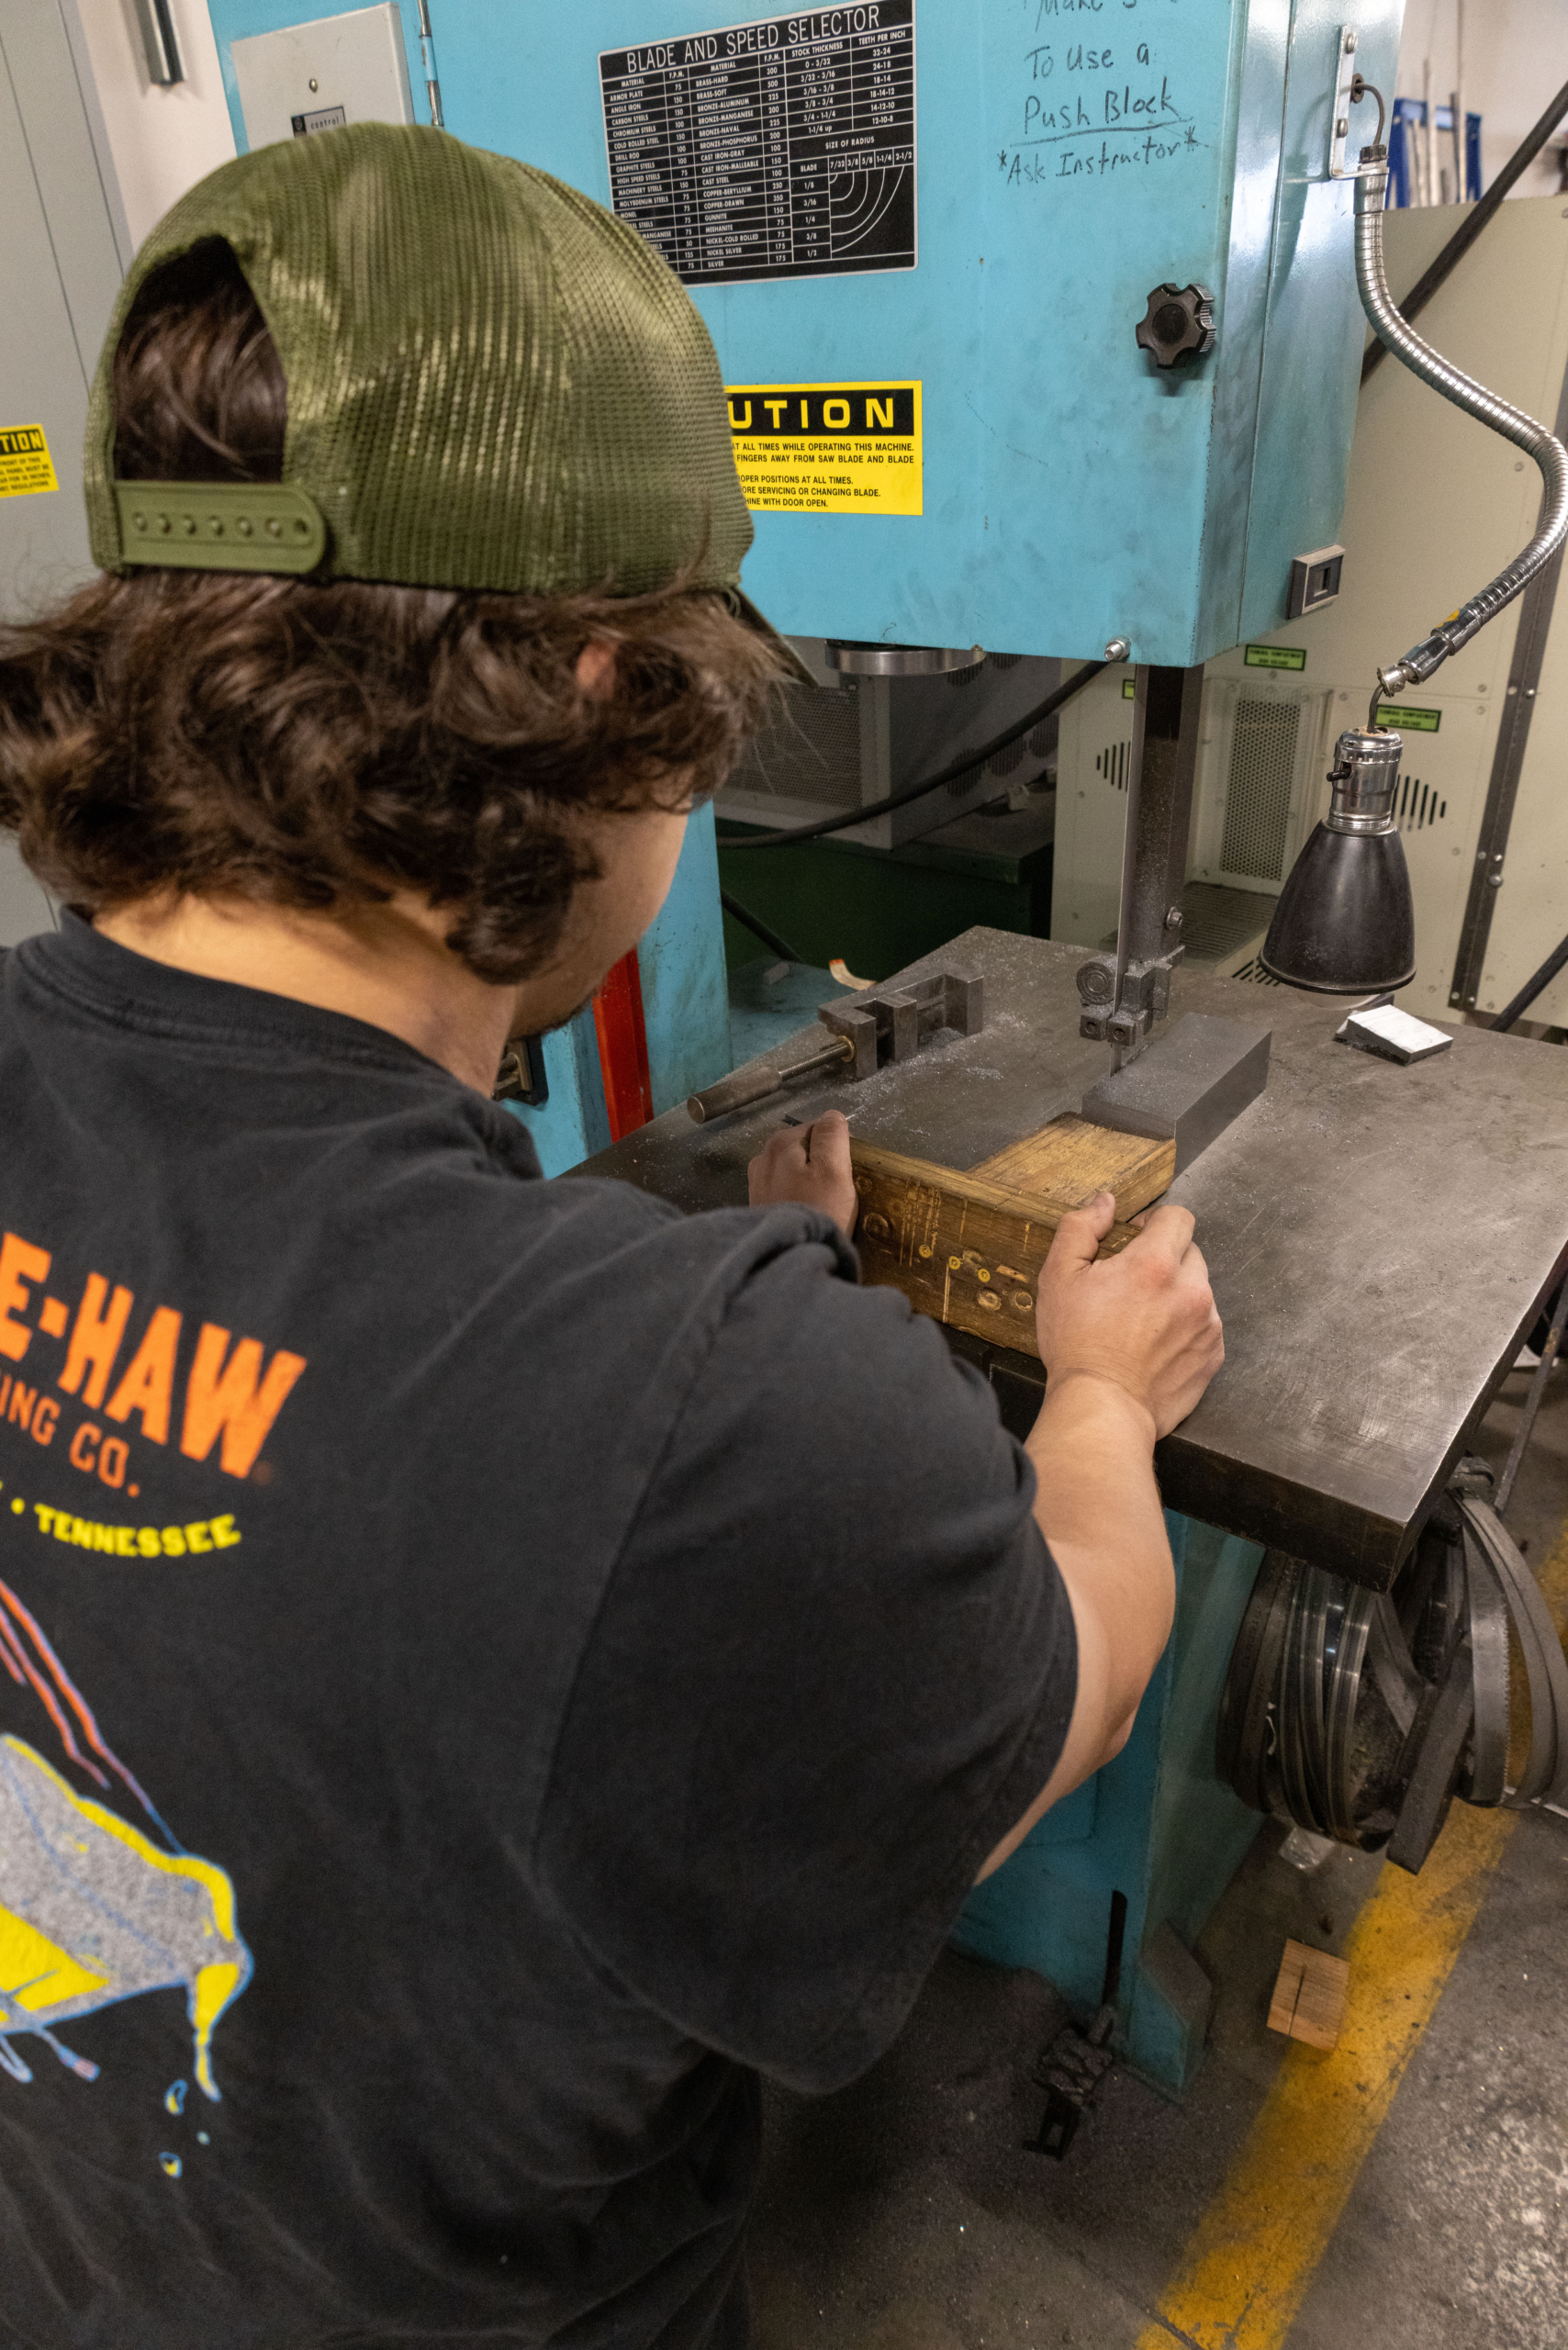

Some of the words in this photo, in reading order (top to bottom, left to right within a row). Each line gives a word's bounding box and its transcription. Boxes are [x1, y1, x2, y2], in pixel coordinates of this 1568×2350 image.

[628, 45, 677, 74] BLADE
[685, 37, 718, 63] AND
[726, 25, 778, 54] SPEED
[789, 6, 879, 44] SELECTOR
[858, 36, 875, 46] TEETH
[878, 33, 889, 42] PER
[890, 30, 905, 39] INCH
[792, 48, 810, 58] STOCK
[812, 42, 843, 55] THICKNESS
[873, 47, 890, 57] 32-24
[765, 53, 780, 62] F.P.M.
[816, 57, 830, 68] 3/32
[1025, 45, 1054, 80] To
[1067, 44, 1114, 71] Use
[711, 62, 735, 72] MATERIAL
[873, 61, 890, 71] 24-18
[669, 71, 684, 79] F.P.M.
[801, 73, 815, 83] 3/32
[822, 71, 835, 80] 3/16
[874, 75, 890, 84] 18-14
[622, 78, 644, 87] MATERIAL
[696, 76, 728, 87] BRASS-HARD
[767, 80, 778, 88] 500
[697, 88, 727, 100] BRASS-SOFT
[804, 88, 816, 96] 3/16
[823, 84, 834, 94] 3/8
[870, 88, 895, 98] 18-14-12
[610, 94, 627, 102] ARMOR
[630, 90, 643, 98] PLATE
[768, 93, 778, 101] 225
[698, 97, 749, 112] BRONZE-ALUMINUM
[805, 99, 815, 109] 3/8
[823, 97, 833, 106] 3/4
[871, 102, 895, 111] 14-12-10
[1025, 95, 1090, 134] Push
[1105, 75, 1182, 124] Block
[611, 106, 626, 114] ANGLE
[612, 117, 632, 126] CARBON
[633, 114, 648, 123] STEELS
[699, 110, 753, 125] BRONZE-MANGANESE
[804, 113, 814, 122] 3/4
[821, 110, 835, 119] 1-1/4
[872, 116, 893, 125] 12-10-8
[613, 129, 640, 138] CHROMIUM
[641, 125, 655, 133] STEELS
[700, 125, 739, 137] BRONZE-NAVAL
[809, 125, 823, 134] 1-1/4
[614, 141, 626, 150] COLD
[628, 139, 645, 147] ROLLED
[700, 135, 757, 150] BRONZE-PHOSPHORUS
[825, 141, 838, 150] SIZE
[852, 136, 875, 146] RADIUS
[701, 153, 713, 162] CAST
[715, 150, 745, 159] IRON-GRAY
[831, 160, 845, 169] 7/32
[848, 159, 858, 167] 3/8
[862, 157, 873, 165] 5/8
[877, 154, 891, 163] 1-1/4
[896, 151, 913, 162] 2-1/2
[616, 163, 639, 173] GRAPHITE
[640, 162, 655, 170] STEELS
[716, 160, 758, 172] IRON-MALLEABLE
[801, 164, 817, 173] BLADE
[617, 176, 629, 185] HIGH
[645, 173, 660, 181] STEELS
[619, 187, 645, 196] MACHINERY
[647, 185, 662, 193] STEELS
[703, 186, 751, 197] COPPER-BERYLLIUM
[804, 182, 814, 190] 1/8
[704, 199, 744, 209] COPPER-DRAWN
[804, 198, 816, 207] 3/16
[705, 213, 727, 221] GUNNITE
[806, 216, 815, 224] 1/4
[706, 224, 733, 233] MEEHANITE
[706, 236, 738, 244] NICKEL-COLD
[806, 232, 817, 241] 3/8
[808, 250, 817, 258] 1/2
[728, 398, 893, 429] UTION
[0, 431, 42, 453] TION
[876, 443, 913, 452] MACHINE.
[829, 476, 853, 485] TIMES.
[854, 488, 880, 497] BLADE.
[0, 1232, 307, 1479] E-HAW
[70, 1422, 140, 1497] CO.
[34, 1504, 241, 1557] TENNESSEE
